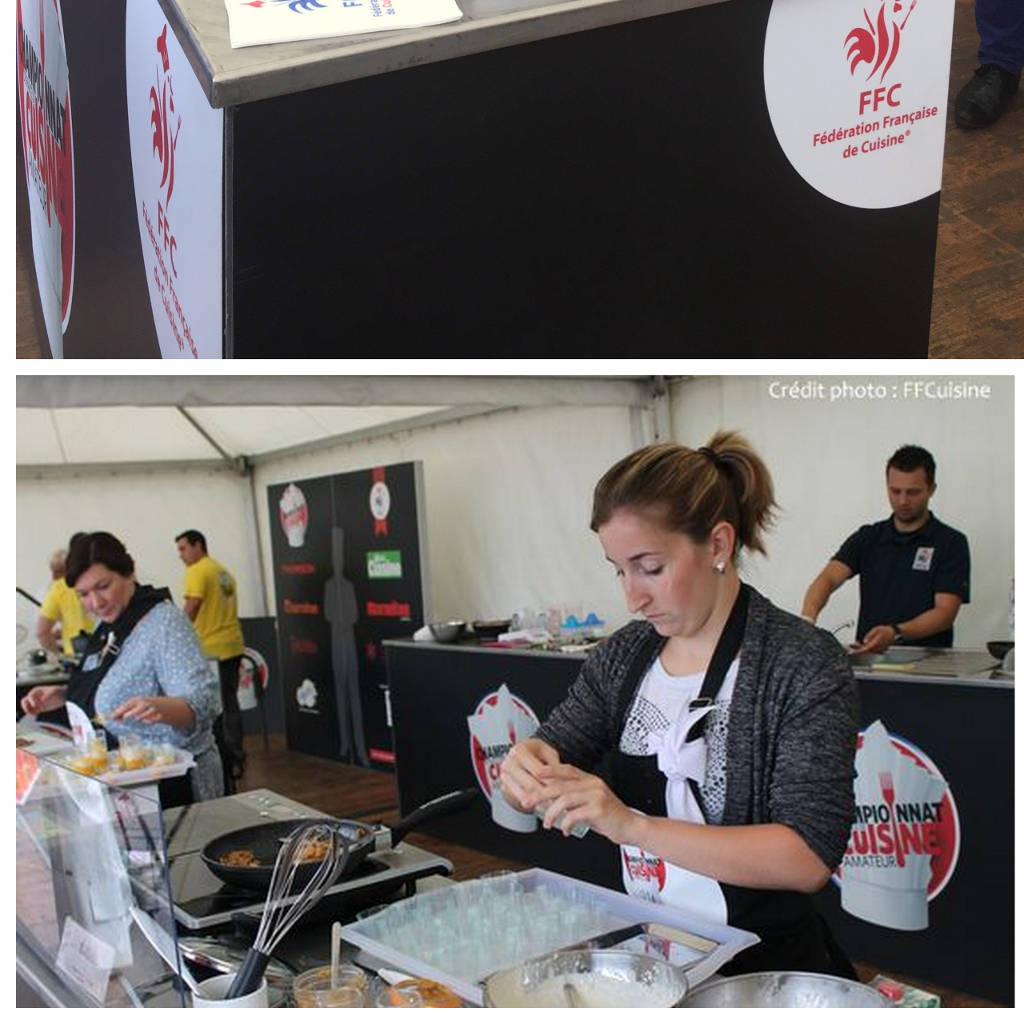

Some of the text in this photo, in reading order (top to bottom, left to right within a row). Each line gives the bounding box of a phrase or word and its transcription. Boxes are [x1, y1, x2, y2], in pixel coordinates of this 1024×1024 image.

[859, 83, 902, 115] FFC
[812, 106, 938, 147] Fédération Française
[843, 145, 858, 159] de
[157, 200, 178, 279] FFC
[845, 824, 945, 857] UISINE
[843, 856, 897, 868] AMATEUR
